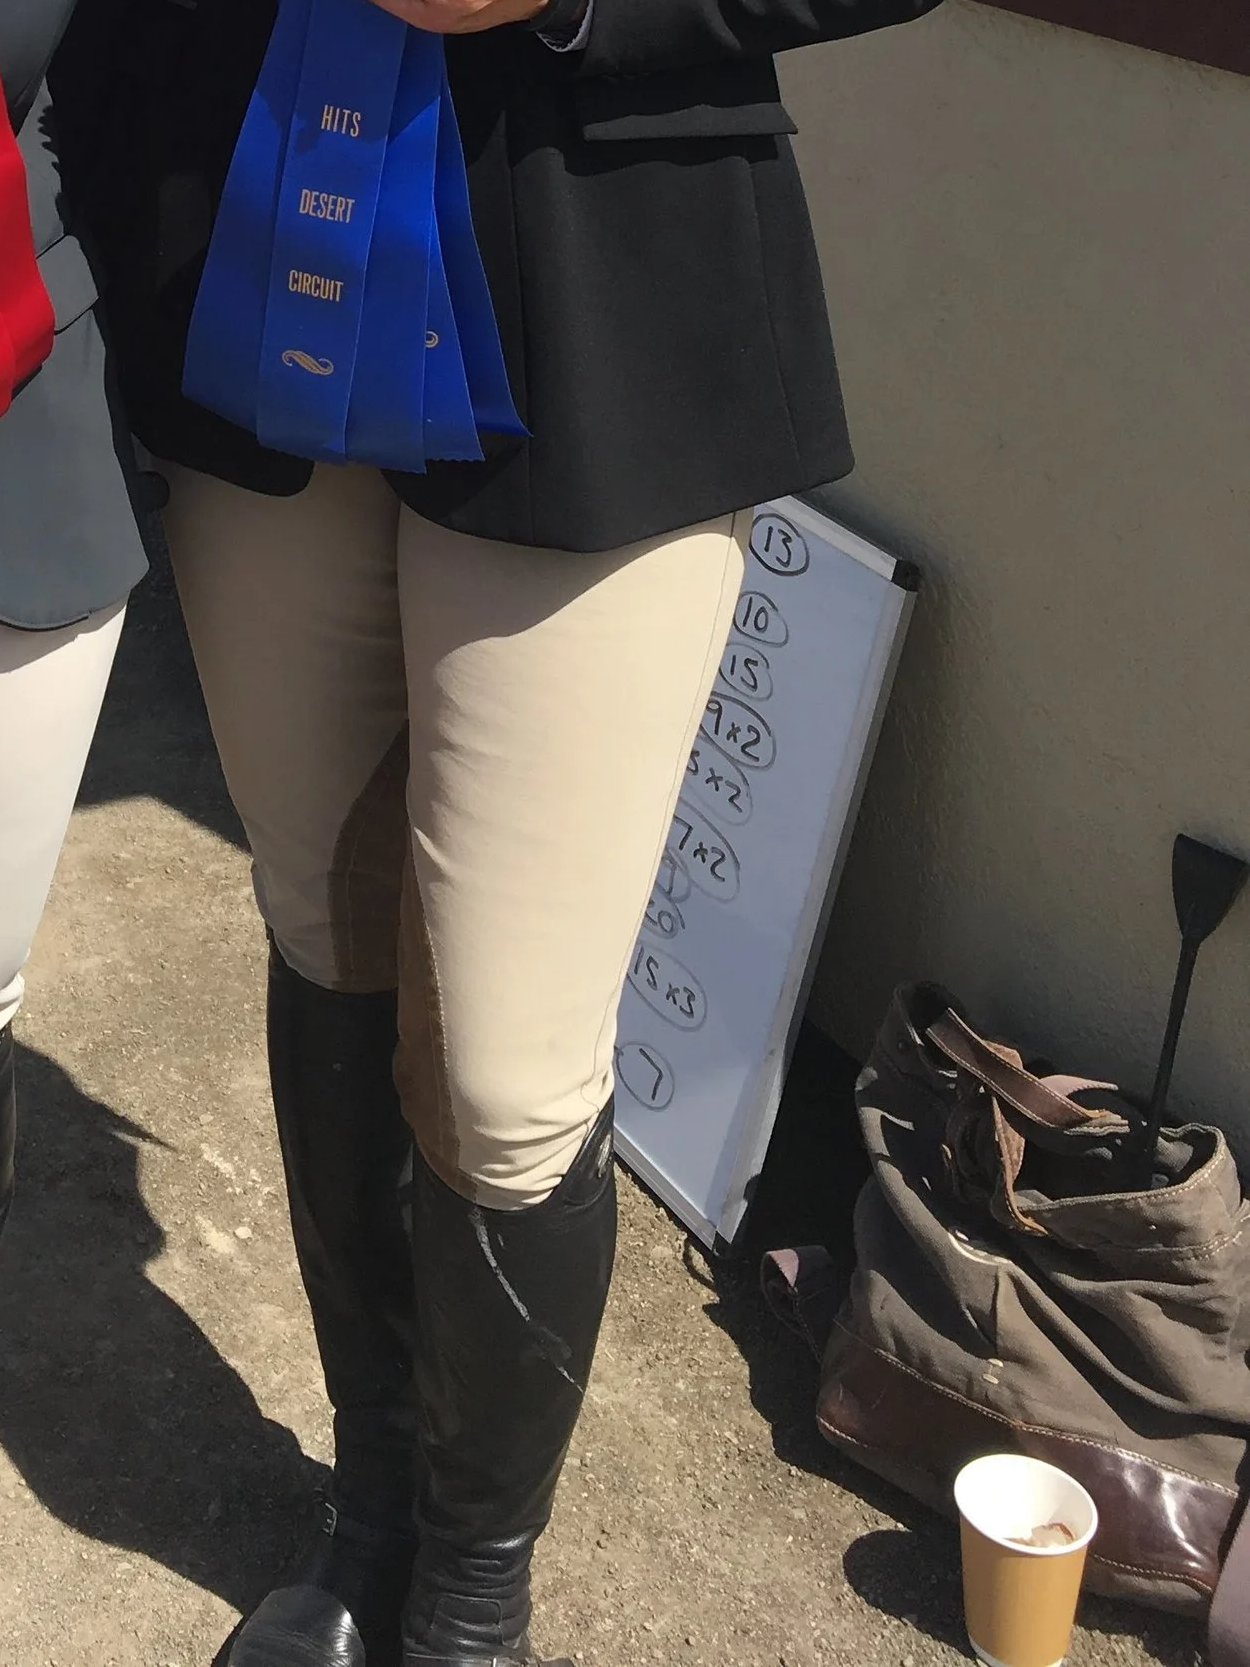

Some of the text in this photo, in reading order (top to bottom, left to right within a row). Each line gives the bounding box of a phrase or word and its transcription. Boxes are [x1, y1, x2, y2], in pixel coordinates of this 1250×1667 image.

[321, 104, 361, 137] HITS
[298, 188, 355, 224] DESERT
[288, 269, 344, 303] CIRCUIT
[764, 525, 793, 568] 13
[742, 596, 769, 633] 10
[639, 1047, 664, 1101] 7
